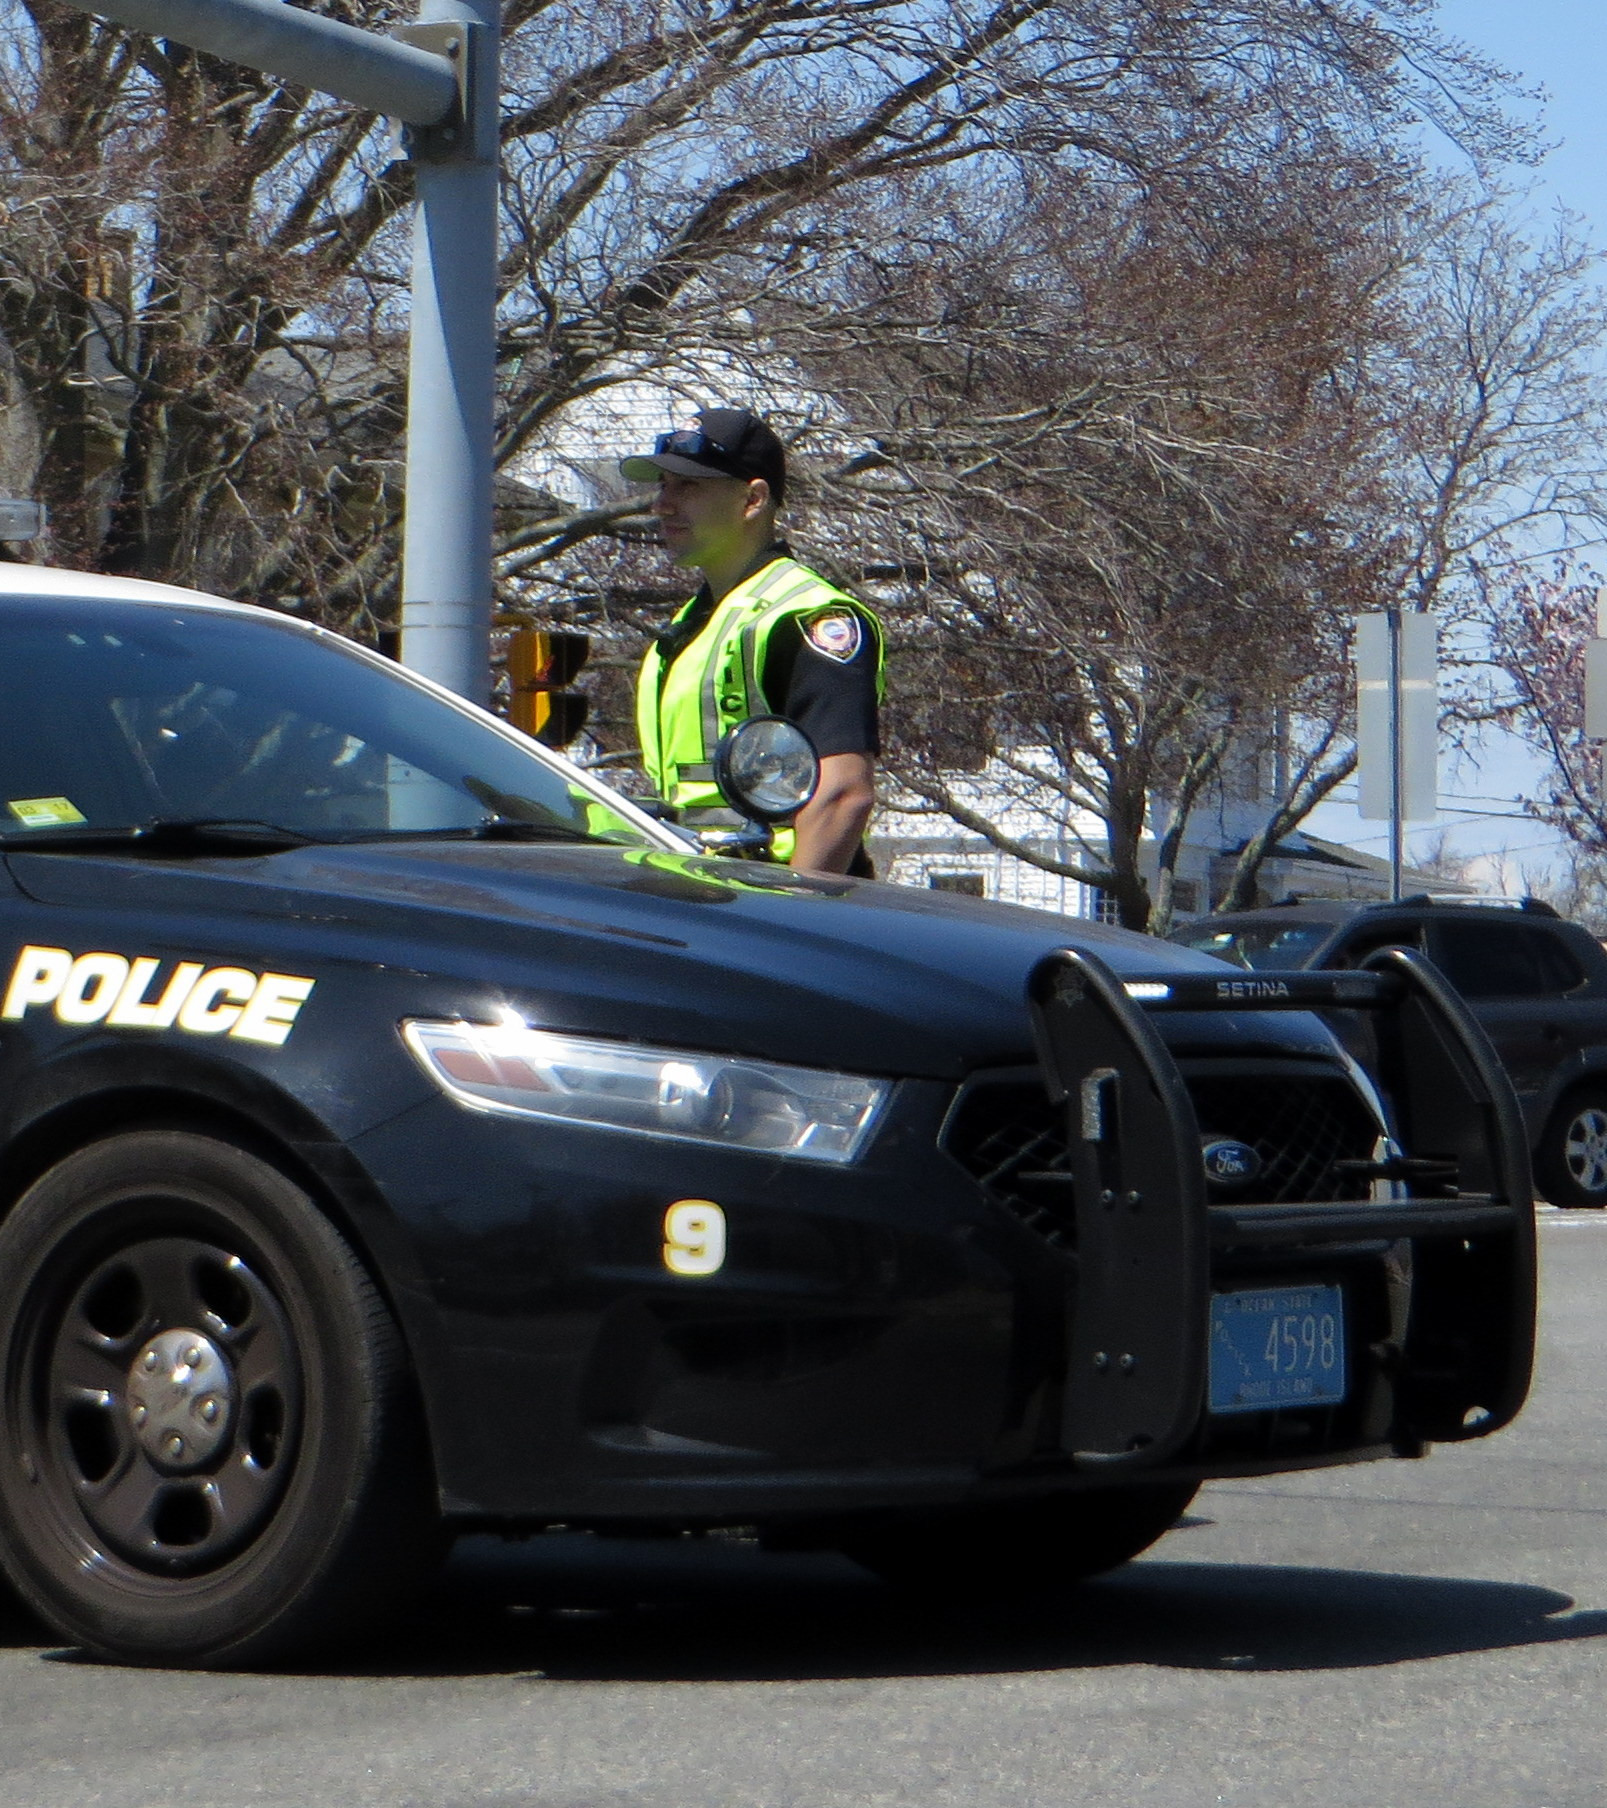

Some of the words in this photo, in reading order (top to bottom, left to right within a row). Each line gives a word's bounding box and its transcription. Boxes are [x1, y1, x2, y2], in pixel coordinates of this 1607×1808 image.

[1216, 981, 1290, 998] SETINA
[663, 1199, 727, 1276] 9
[1263, 1313, 1336, 1374] 4598
